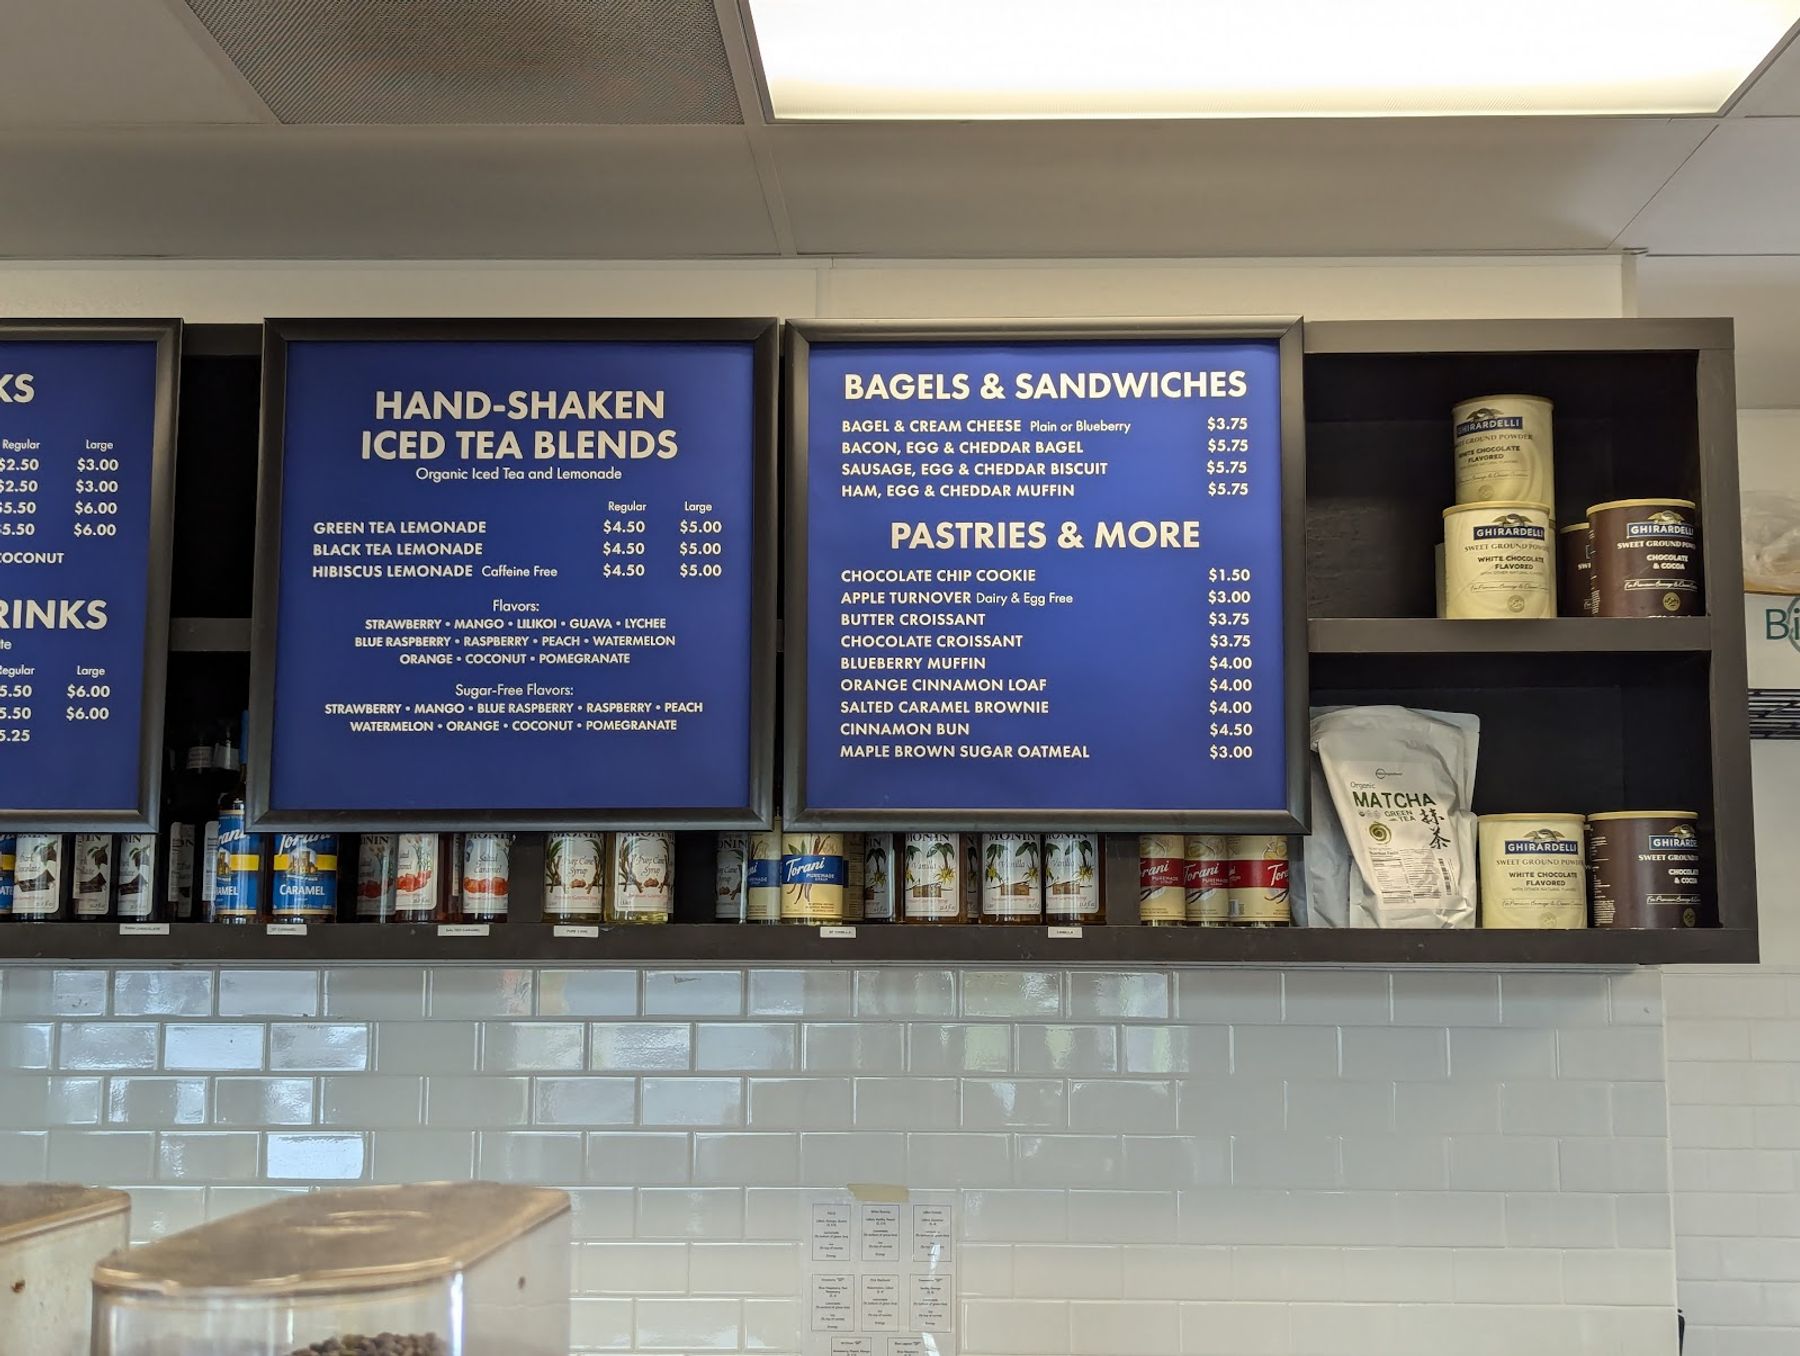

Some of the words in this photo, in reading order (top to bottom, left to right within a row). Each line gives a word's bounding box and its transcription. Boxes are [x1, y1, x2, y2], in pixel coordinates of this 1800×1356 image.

[846, 374, 969, 399] BAGELS
[981, 373, 1005, 399] &
[1016, 371, 1246, 399] SANDWICHES
[376, 391, 664, 419] HAND-SHAKEN
[843, 420, 889, 432] BAGEL
[894, 420, 904, 432] &
[910, 420, 961, 432] CREAM
[967, 420, 1021, 432] CHEESE
[1031, 420, 1057, 432] Plain
[1076, 420, 1131, 434] Blueberry
[1208, 417, 1247, 431] $3.75
[3, 439, 40, 452] Regular
[86, 440, 113, 452] Large
[362, 431, 445, 459] ICED
[456, 431, 523, 459] TEA
[535, 430, 677, 459] BLENDS
[842, 442, 901, 455] BACON,
[907, 442, 938, 453] EGG
[944, 442, 954, 453] &
[959, 442, 1030, 453] CHEDDAR
[1036, 441, 1083, 453] BAGEL
[1208, 438, 1248, 453] $5.75
[77, 458, 118, 472] $3.00
[842, 463, 915, 477] SAUSAGE,
[922, 464, 953, 475] EGG
[959, 463, 969, 475] &
[975, 463, 1045, 475] CHEDDAR
[1051, 463, 1108, 475] BISCUIT
[1207, 460, 1247, 474] $5.75
[416, 468, 468, 482] Organic
[473, 467, 499, 479] Iced
[503, 468, 524, 479] Tea
[528, 467, 552, 479] and
[557, 466, 622, 479] Lemonade
[76, 479, 118, 493] $3.00
[842, 485, 881, 498] HAM,
[887, 485, 919, 496] EGG
[925, 485, 935, 496] &
[940, 485, 1011, 496] CHEDDAR
[1016, 485, 1074, 496] MUFFIN
[1208, 482, 1248, 496] $5.75
[75, 501, 117, 515] $6.00
[609, 501, 646, 513] Regular
[685, 501, 712, 513] Large
[74, 523, 116, 537] $6.00
[314, 522, 364, 534] GREEN
[369, 522, 395, 533] TEA
[401, 522, 486, 533] LEMONADE
[604, 520, 645, 534] $4.50
[680, 520, 722, 534] $5.00
[1476, 527, 1544, 538] GHIRARDELLI
[1630, 525, 1694, 536] GHIRARDELLI
[892, 522, 1046, 549] PASTRIES
[1058, 522, 1084, 548] &
[1095, 521, 1199, 548] MORE
[314, 544, 361, 555] BLACK
[365, 544, 392, 555] TEA
[397, 543, 482, 555] LEMONADE
[603, 542, 644, 556] $4.50
[680, 542, 721, 556] $5.00
[1617, 541, 1644, 550] SWEET
[1646, 540, 1682, 548] GROUND
[1646, 554, 1689, 562] CHOCOLATE
[313, 566, 382, 577] HIBISCUS
[388, 565, 472, 577] LEMONADE
[482, 565, 530, 576] Caffeine
[534, 566, 557, 576] Free
[603, 563, 644, 577] $4.50
[680, 563, 722, 577] $5.00
[1653, 562, 1660, 570] &
[1661, 562, 1685, 570] COCOA
[841, 570, 931, 582] CHOCOLATE
[937, 570, 971, 581] CHIP
[976, 570, 1035, 581] COOKIE
[1209, 568, 1250, 582] $1.50
[493, 599, 539, 611] Flavors:
[841, 592, 885, 604] APPLE
[889, 592, 971, 603] TURNOVER
[977, 593, 1007, 606] Dairy
[1011, 592, 1019, 603] &
[1024, 592, 1045, 606] Egg
[1049, 592, 1073, 603] Free
[1209, 590, 1250, 604] $3.00
[366, 619, 441, 629] STRAWBERRY
[454, 619, 504, 629] MANGO
[517, 619, 556, 628] LILIKOI
[570, 619, 612, 628] GUAVA
[625, 618, 666, 628] LYCHEE
[842, 614, 894, 625] BUTTER
[900, 614, 985, 625] CROISSANT
[1209, 612, 1249, 626] $3.75
[1765, 607, 1800, 641] Bi
[355, 637, 383, 647] BLUE
[386, 637, 451, 646] RASPBERRY
[464, 636, 529, 646] RASPBERRY
[542, 636, 580, 646] PEACH
[593, 636, 675, 645] WATERMELON
[841, 635, 931, 647] CHOCOLATE
[937, 635, 1023, 647] CROISSANT
[1210, 634, 1250, 648] $3.75
[400, 654, 452, 664] ORANGE
[465, 654, 526, 664] COCONUT
[539, 653, 630, 663] POMEGRANATE
[841, 658, 922, 669] BLUEBERRY
[928, 658, 985, 669] MUFFIN
[1210, 656, 1252, 670] $4.00
[77, 666, 105, 678] Large
[67, 684, 110, 698] $6.00
[456, 684, 523, 698] Sugar-Free
[527, 683, 573, 695] Flavors:
[841, 679, 907, 691] ORANGE
[912, 679, 1002, 691] CINNAMON
[1009, 679, 1046, 691] LOAF
[1210, 678, 1252, 692] $4.00
[66, 706, 109, 721] $6.00
[325, 704, 401, 714] STRAWBERRY
[415, 704, 464, 713] MANGO
[478, 703, 505, 713] BLUE
[509, 703, 573, 713] RASPBERRY
[587, 703, 652, 712] RASPBERRY
[665, 702, 702, 712] PEACH
[841, 701, 893, 713] SALTED
[899, 701, 970, 713] CARAMEL
[975, 701, 1048, 713] BROWNIE
[1210, 700, 1252, 715] $4.00
[841, 723, 931, 735] CINNAMON
[937, 723, 969, 735] BUN
[1210, 723, 1252, 737] $4.50
[841, 746, 889, 757] MAPLE
[895, 746, 955, 757] BROWN
[960, 746, 1012, 757] SUGAR
[1018, 746, 1089, 758] OATMEAL
[1210, 745, 1252, 759] $3.00
[1350, 781, 1376, 790] Organic
[1352, 791, 1437, 809] MATCHA
[1419, 808, 1452, 850] 抹茶
[1507, 843, 1577, 852] GHIRARDELLI
[785, 857, 825, 882] Torani
[279, 884, 325, 896] CARAMEL
